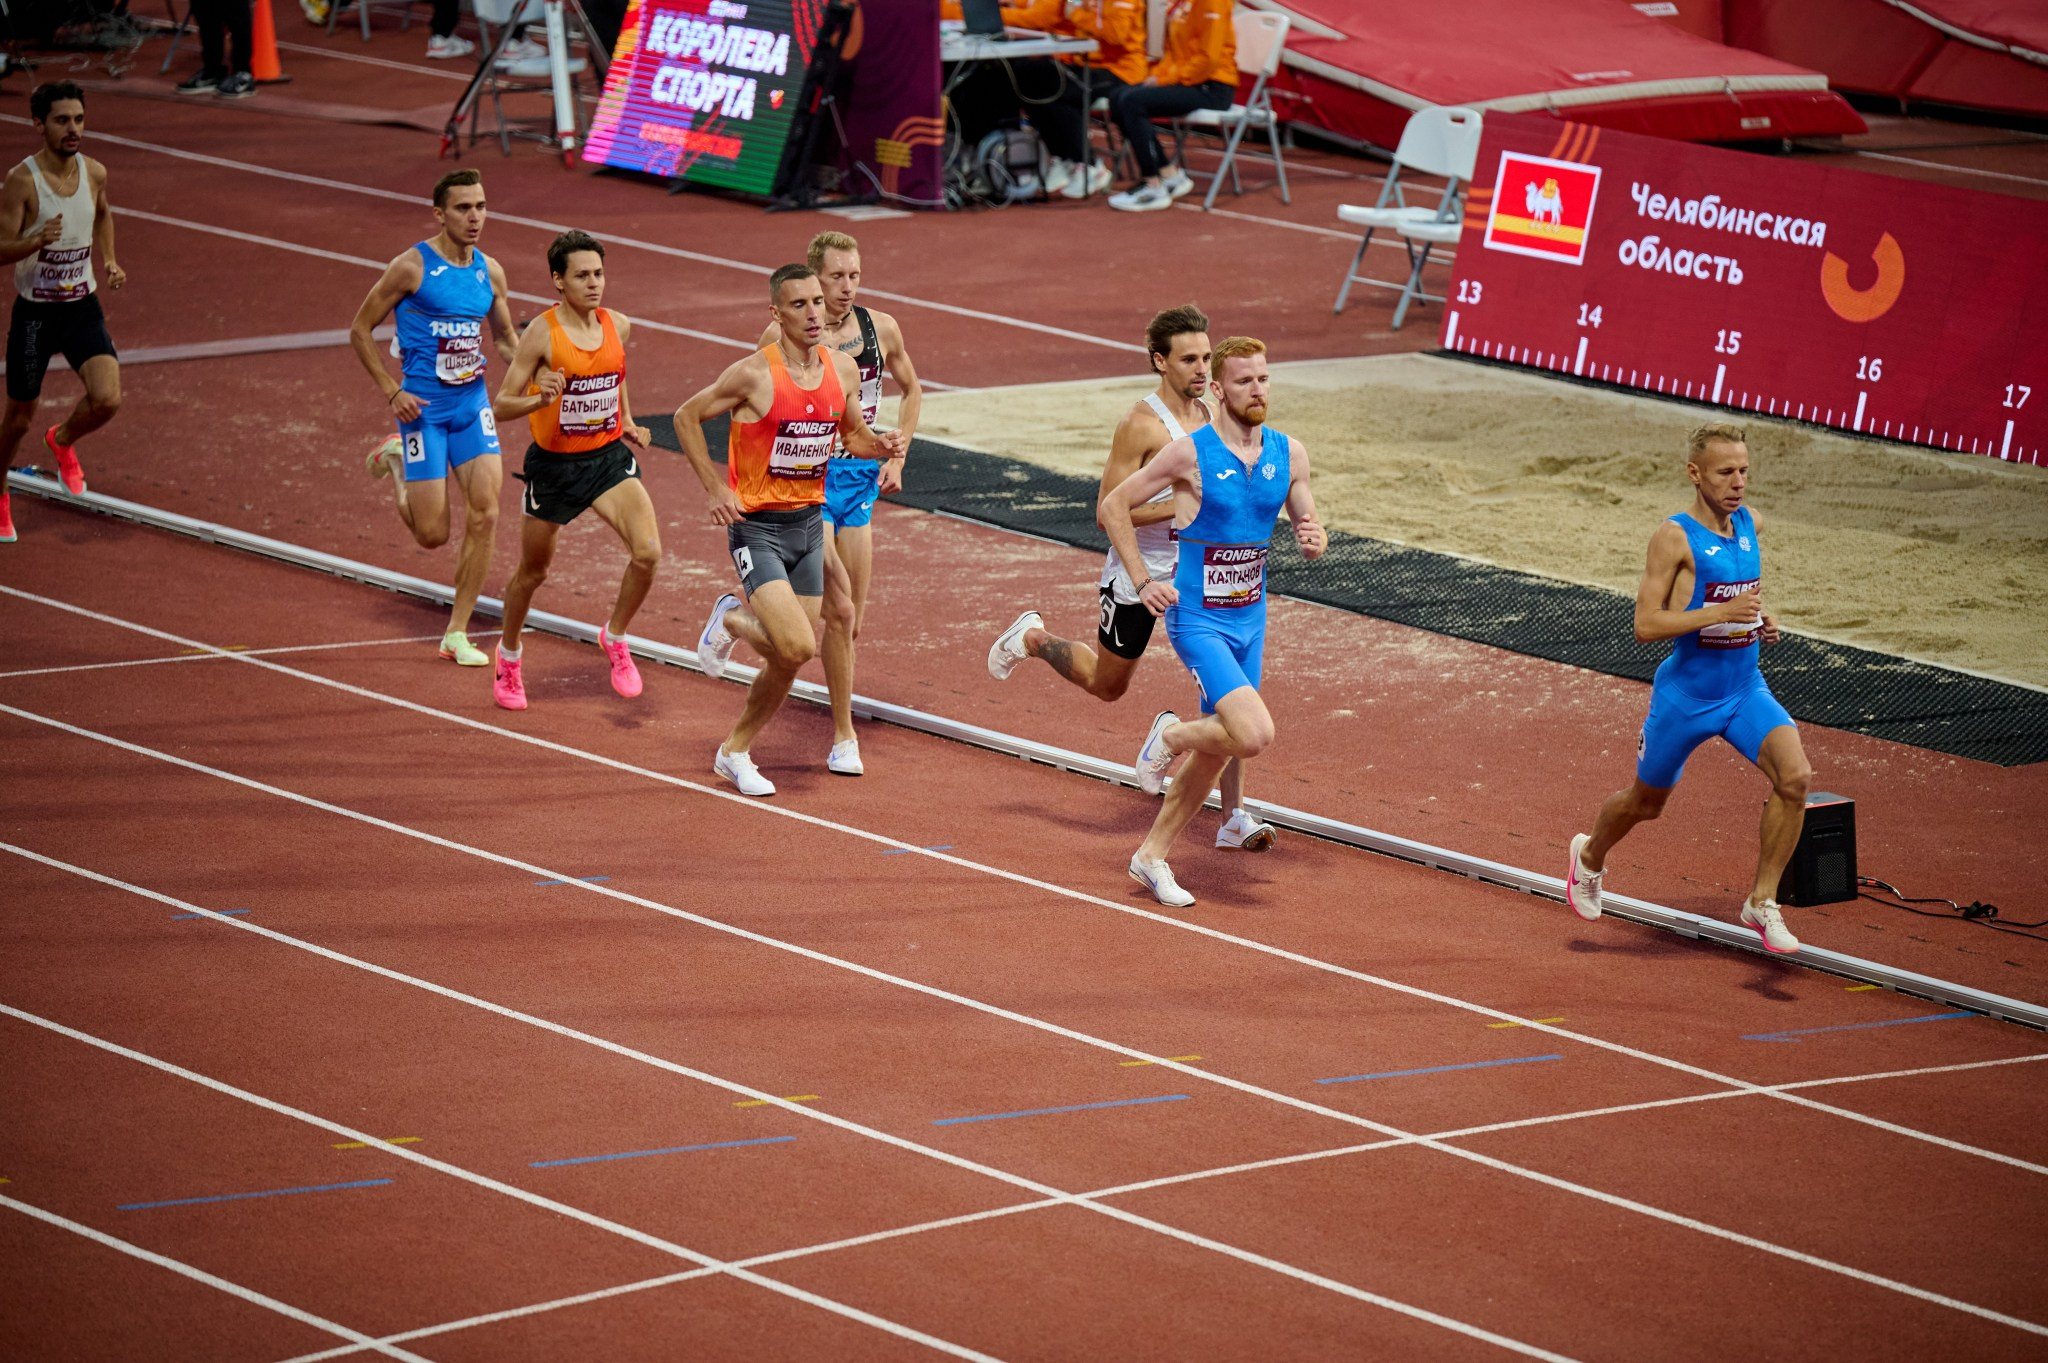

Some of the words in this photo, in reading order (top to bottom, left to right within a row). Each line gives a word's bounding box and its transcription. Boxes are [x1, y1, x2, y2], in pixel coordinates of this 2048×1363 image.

[645, 14, 790, 76] КОРОЛЕВА
[650, 66, 757, 120] СПОРТА
[1631, 181, 1827, 248] Челябинская
[45, 247, 88, 262] FONBET
[1618, 235, 1744, 286] область
[1456, 278, 1483, 305] 13
[429, 320, 480, 338] RUSS
[1576, 302, 1603, 329] 14
[1714, 328, 1742, 355] 15
[1855, 355, 1883, 382] 16
[569, 374, 619, 391] FONBET
[2002, 383, 2031, 410] 17
[485, 412, 494, 431] 3
[785, 421, 835, 435] FONBET
[408, 437, 419, 457] 3
[738, 551, 748, 571] 4
[1100, 595, 1113, 628] 5
